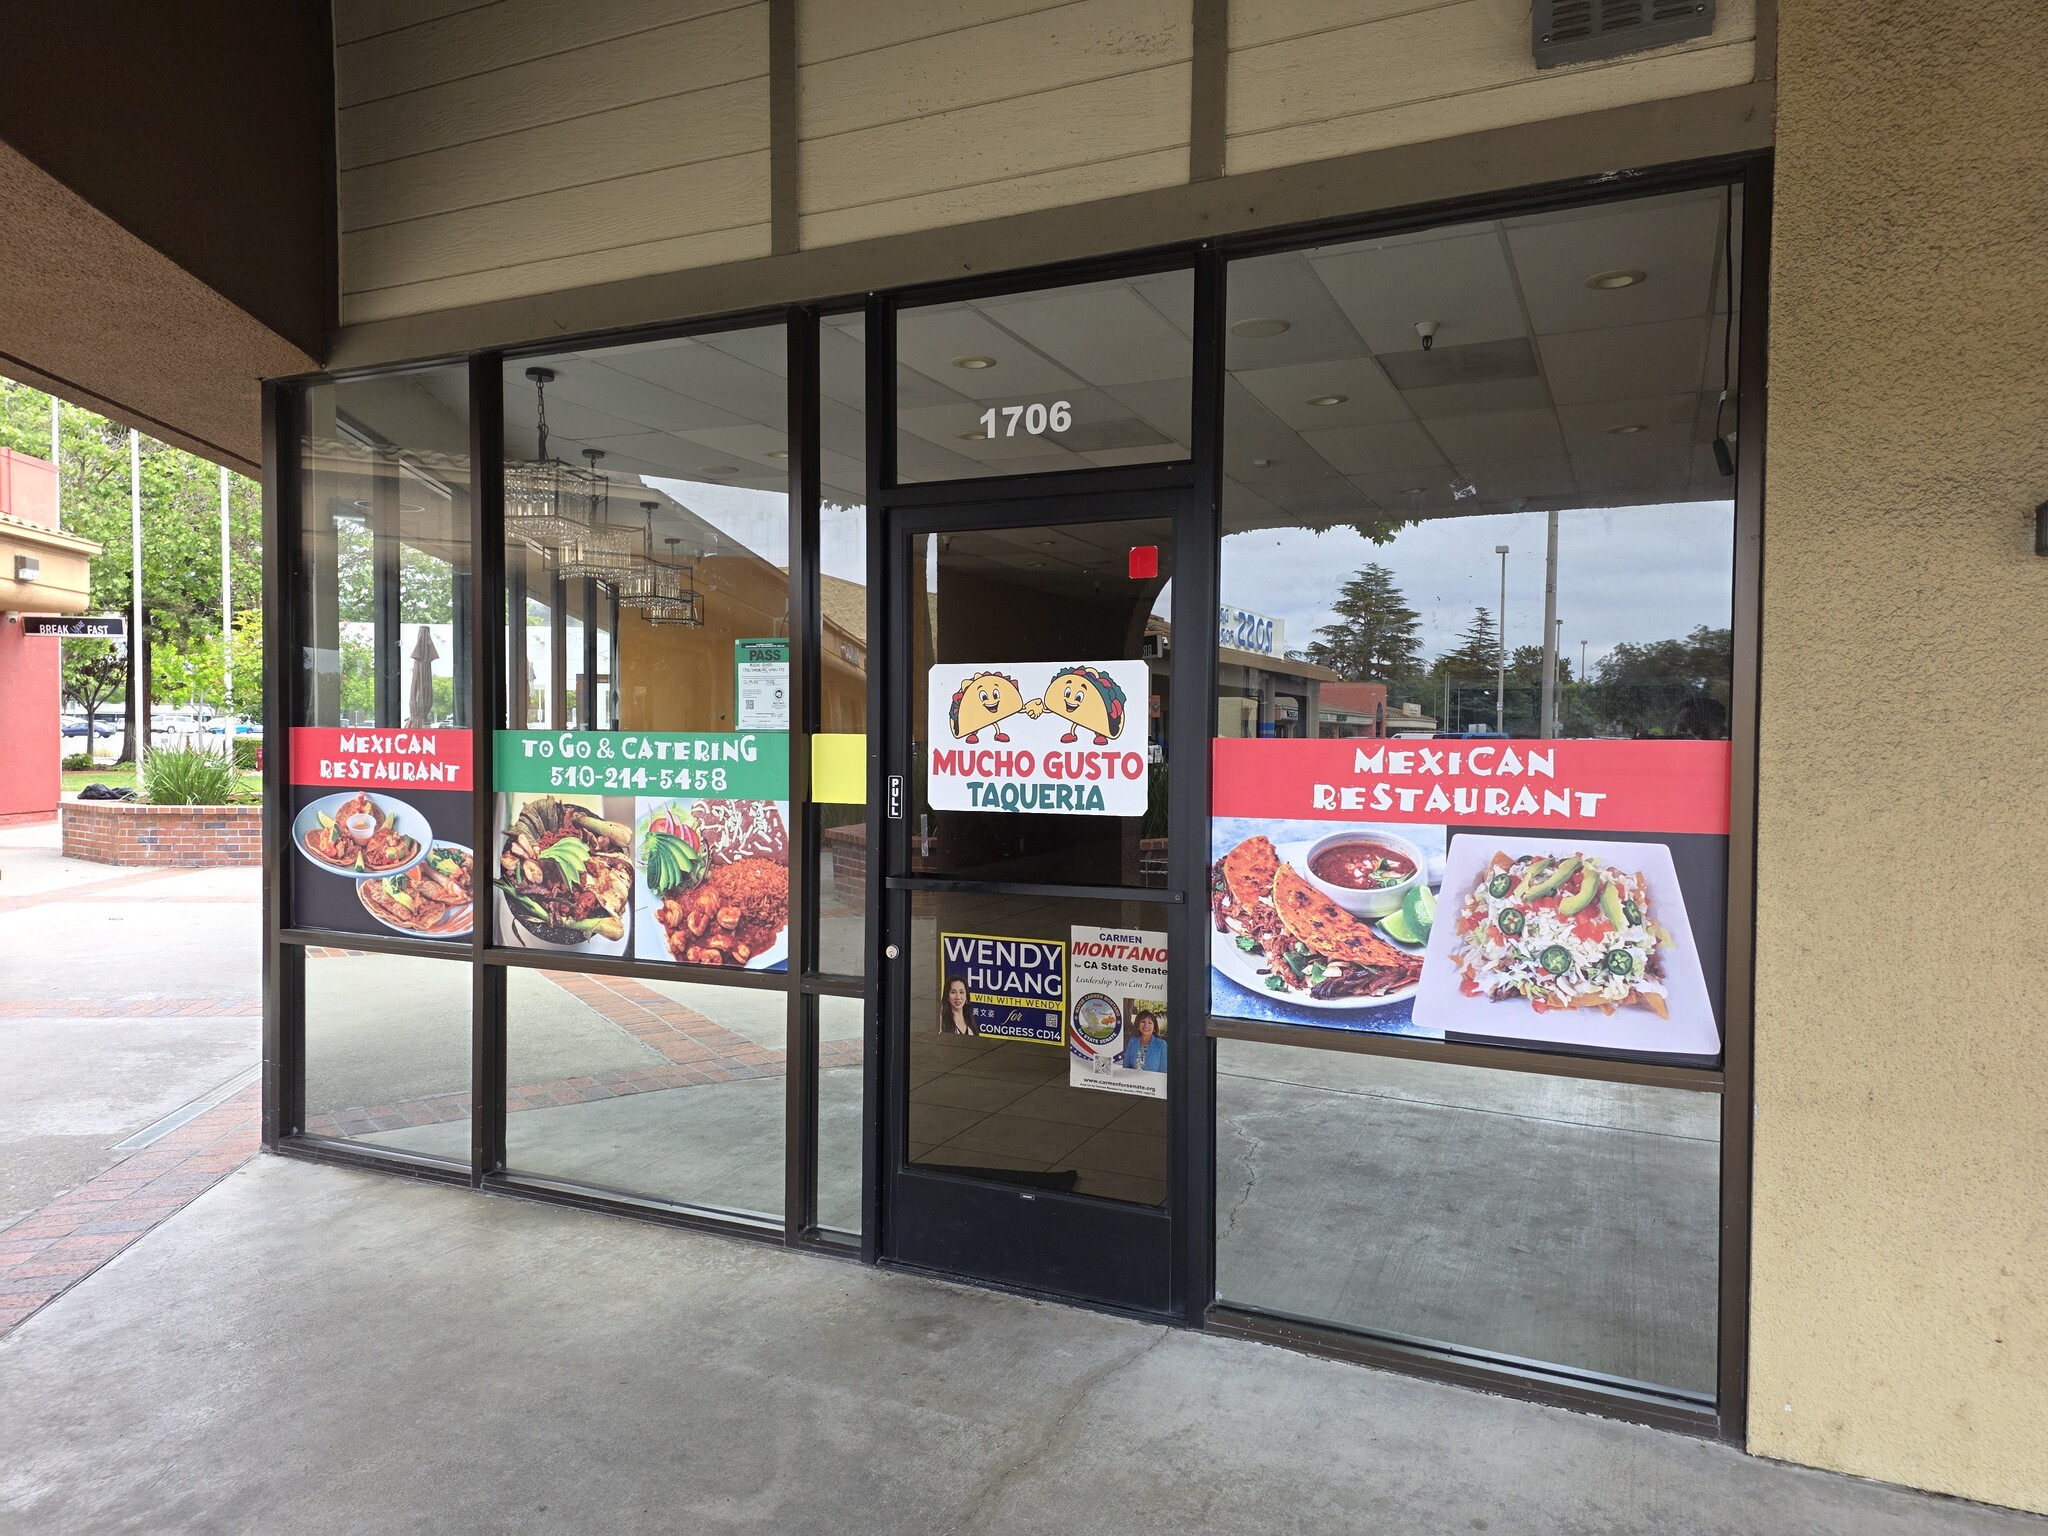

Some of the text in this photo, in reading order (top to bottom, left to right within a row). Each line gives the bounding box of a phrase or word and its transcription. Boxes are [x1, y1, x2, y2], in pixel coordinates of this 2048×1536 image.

[980, 400, 1072, 439] 1706
[39, 624, 70, 635] BREAK
[87, 625, 109, 635] FAST
[749, 649, 782, 661] PASS
[338, 733, 437, 755] MEXICAN
[596, 734, 616, 760] &
[621, 735, 759, 763] CATERING
[319, 758, 461, 783] RESTAURANT
[932, 747, 1145, 780] MUCHO GUSTO
[1354, 746, 1555, 778] MEXICAN
[549, 765, 728, 792] 510-214-5458
[891, 778, 900, 816] PULL
[966, 782, 1106, 813] TAQUERIA
[1312, 783, 1607, 819] RESTAURANT
[1099, 933, 1143, 944] CARMEN
[944, 938, 1062, 970] WENDY
[1072, 941, 1169, 963] MONTANO
[1083, 960, 1099, 970] CA
[1101, 962, 1129, 973] State
[1131, 965, 1169, 976] Senate
[967, 967, 1062, 996] HUANG
[1075, 976, 1164, 990] Leadership You Can Trust
[974, 994, 1061, 1010] WIN WITH WENDY
[1001, 1009, 1023, 1025] for
[979, 1023, 1035, 1038] CONGRESS
[1036, 1029, 1061, 1041] CD14
[1083, 1077, 1156, 1092] www.carmenforsenate.org
